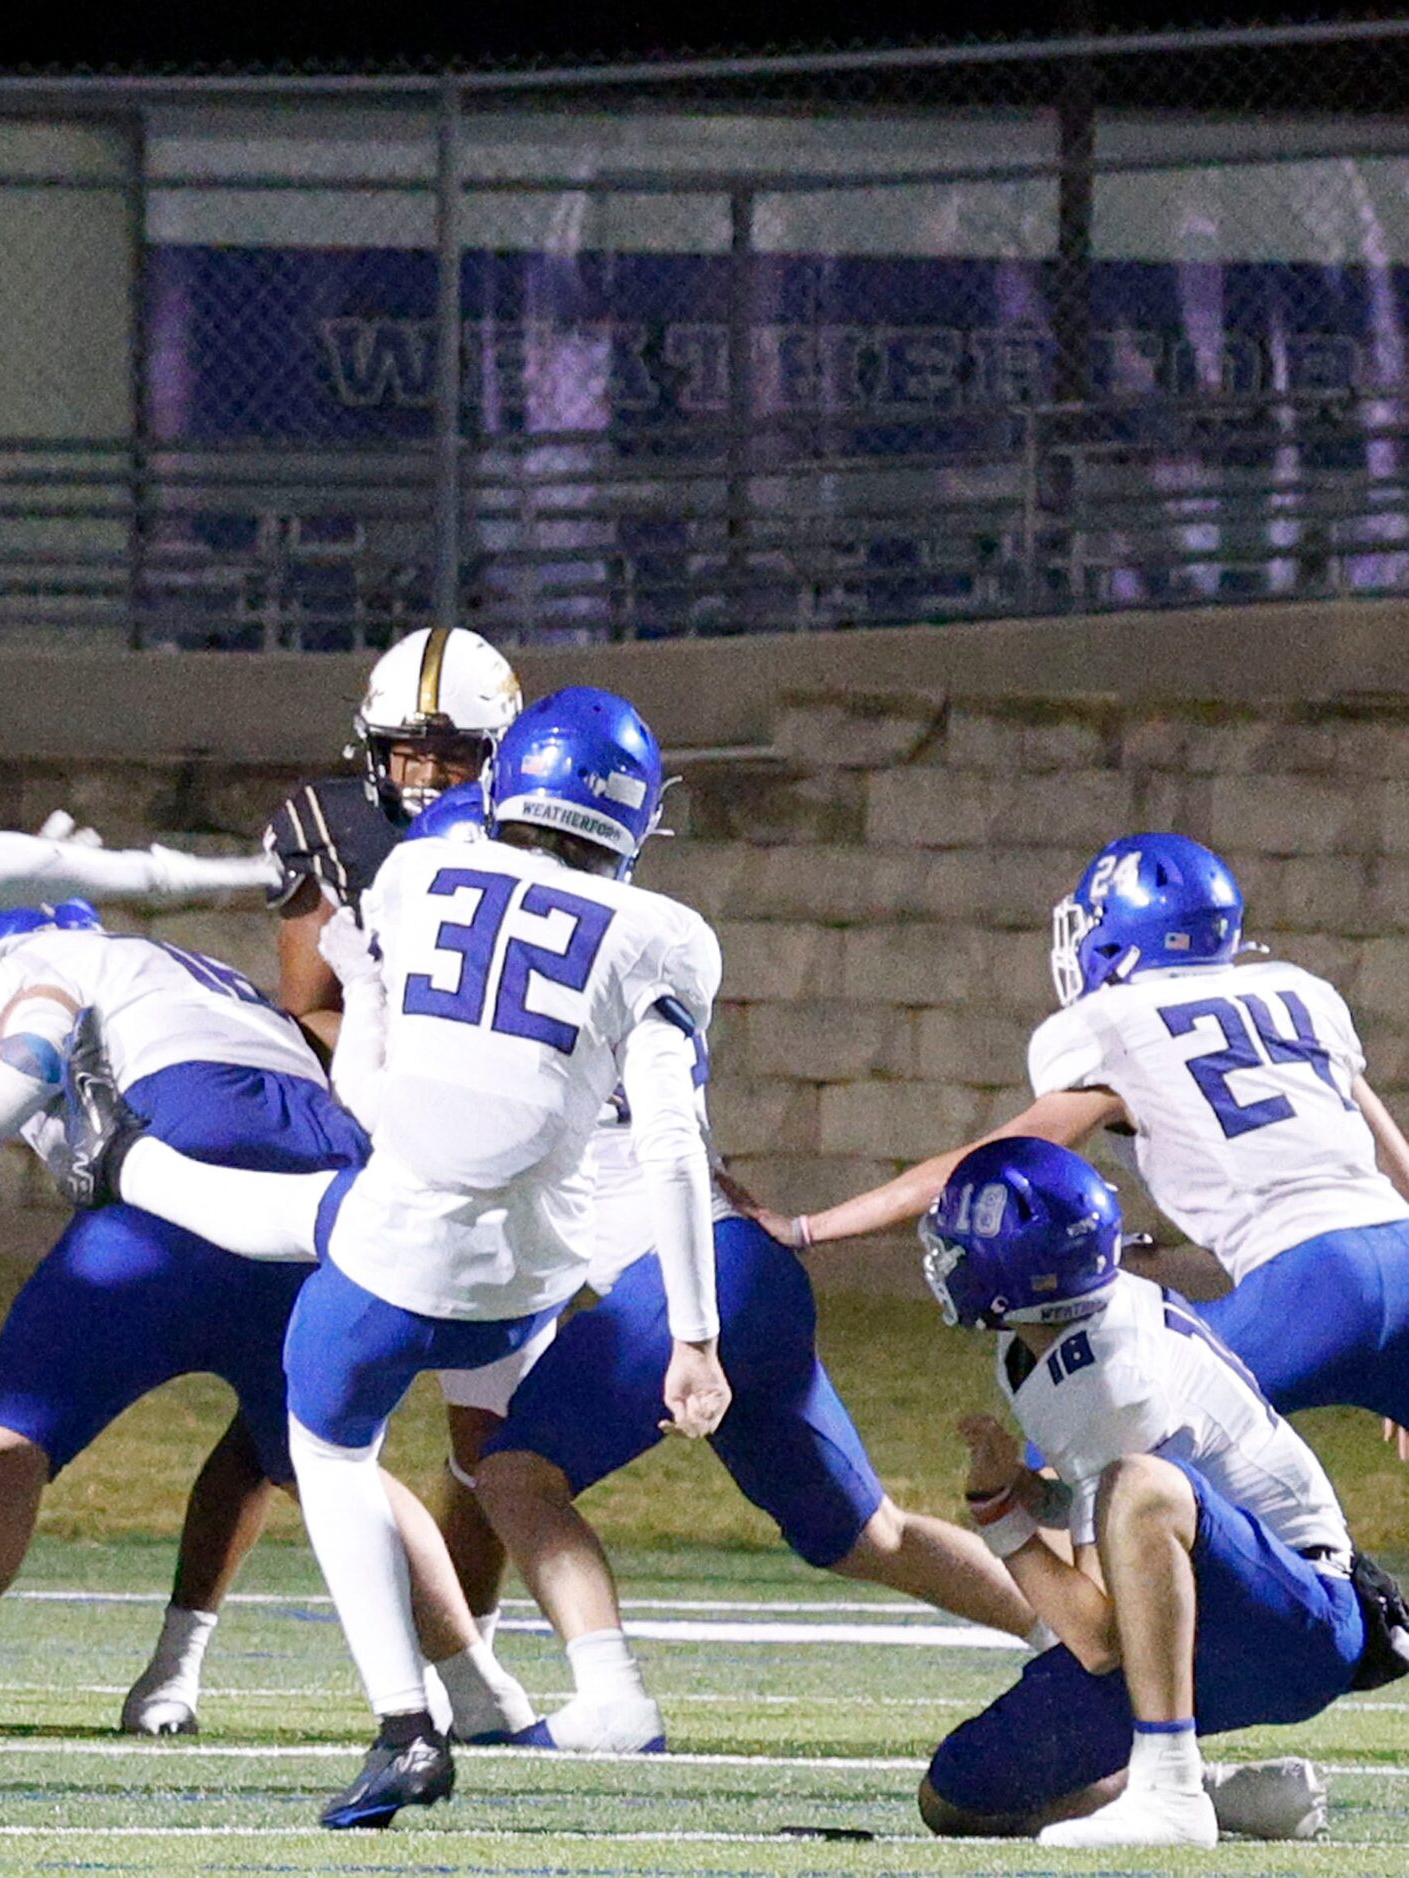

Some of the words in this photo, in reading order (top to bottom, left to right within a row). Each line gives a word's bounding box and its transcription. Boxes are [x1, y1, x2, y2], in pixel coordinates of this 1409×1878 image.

[1089, 850, 1150, 908] 24
[402, 866, 617, 1056] 32
[1156, 990, 1361, 1140] 24
[954, 1182, 1009, 1239] 18
[1045, 1329, 1096, 1387] 18
